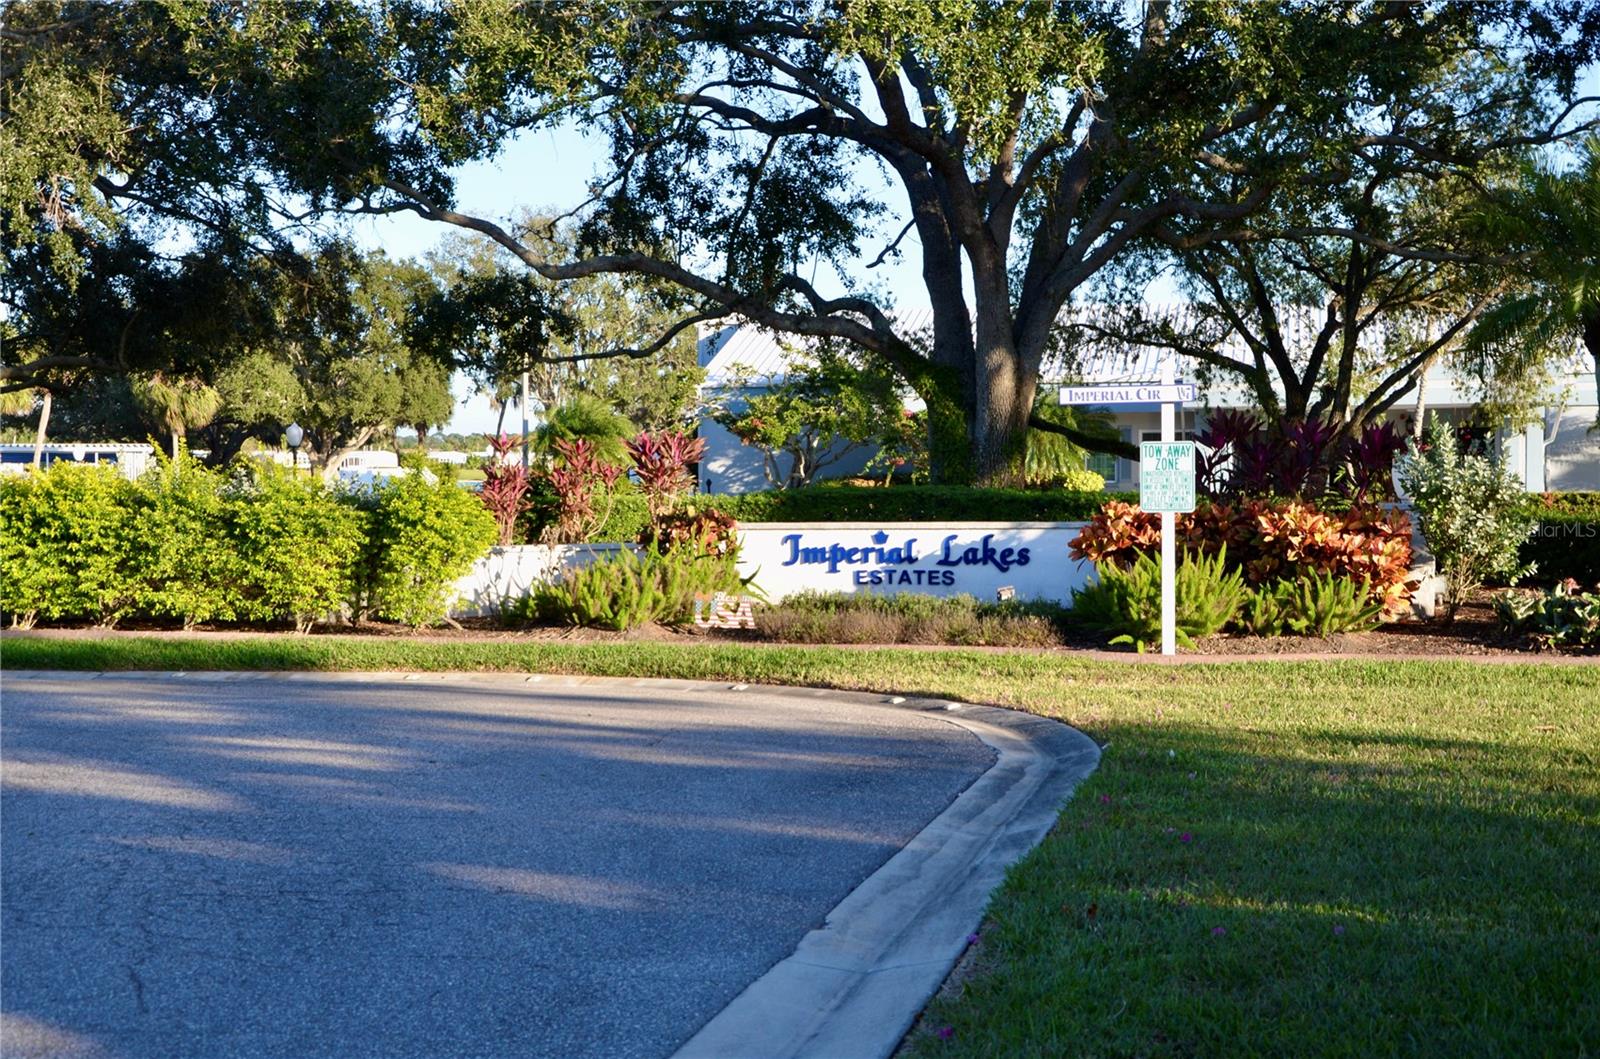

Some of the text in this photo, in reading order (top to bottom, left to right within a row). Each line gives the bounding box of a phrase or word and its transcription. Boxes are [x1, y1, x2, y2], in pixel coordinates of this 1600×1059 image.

[1068, 389, 1132, 402] IMPERIAL
[1136, 388, 1161, 401] CIR
[1143, 445, 1192, 458] TOW AWAY
[1155, 457, 1180, 471] ZONE
[781, 532, 1031, 574] Imperial Lakes
[854, 569, 956, 586] ESTATES
